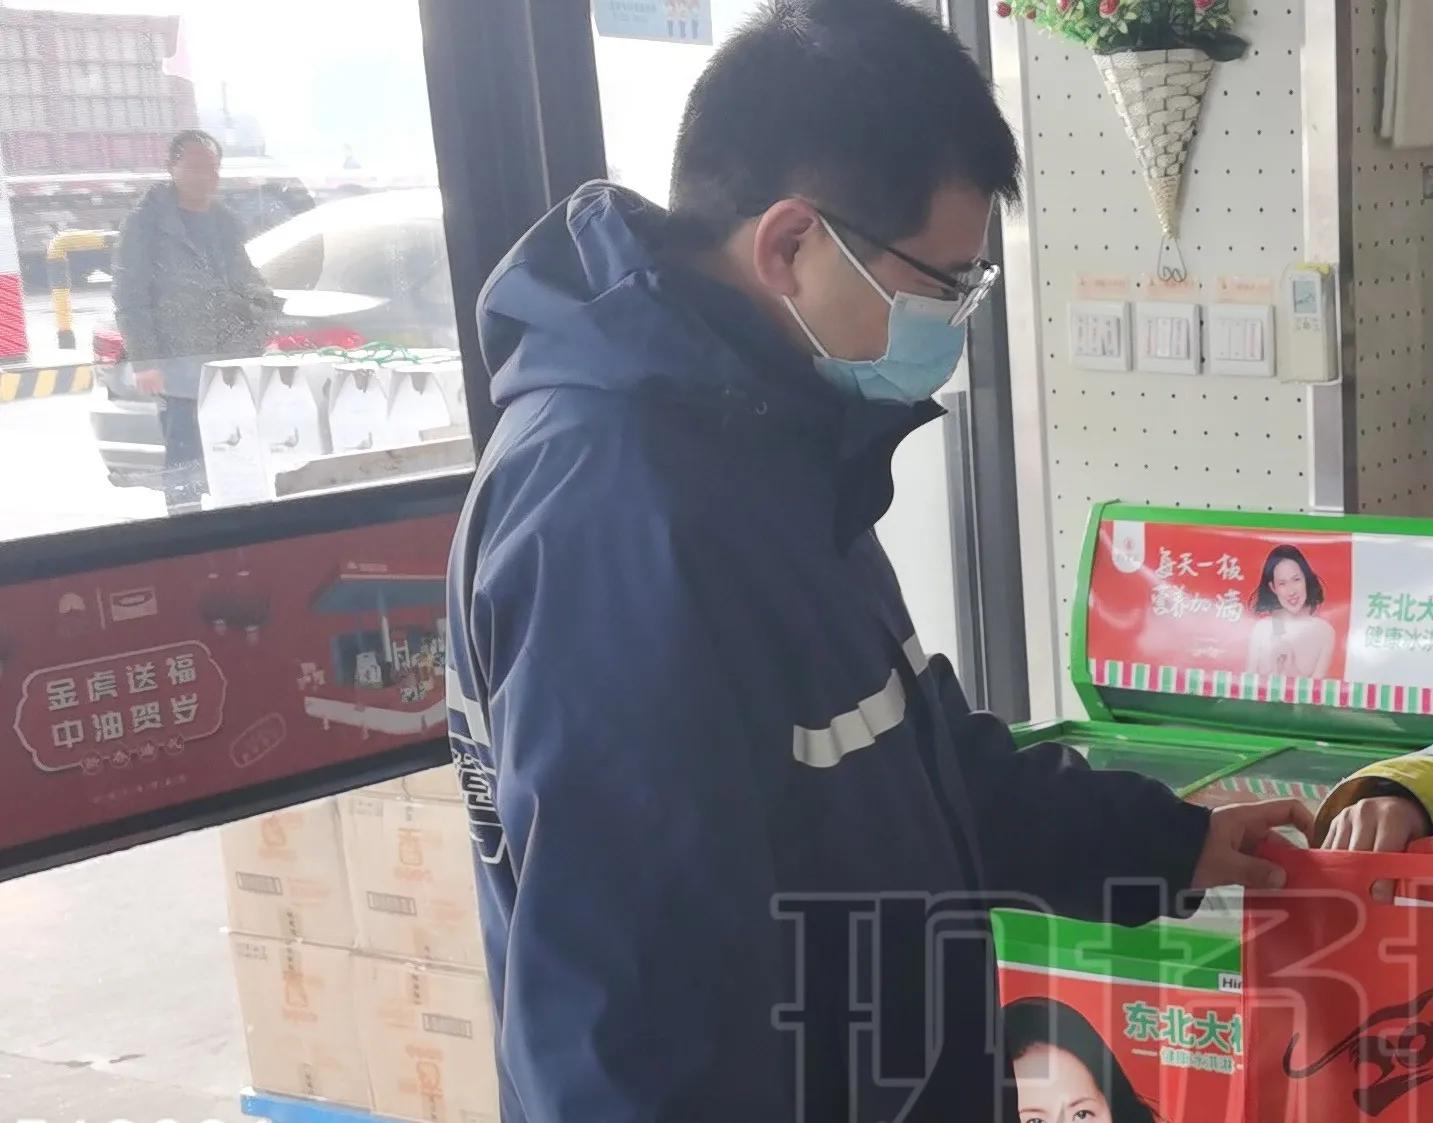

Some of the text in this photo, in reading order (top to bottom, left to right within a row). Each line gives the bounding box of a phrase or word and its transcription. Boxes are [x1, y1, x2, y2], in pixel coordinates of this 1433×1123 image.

[1154, 546, 1244, 582] 每天一板
[46, 653, 197, 712] 金虎送福
[51, 692, 199, 748] 中油贺岁
